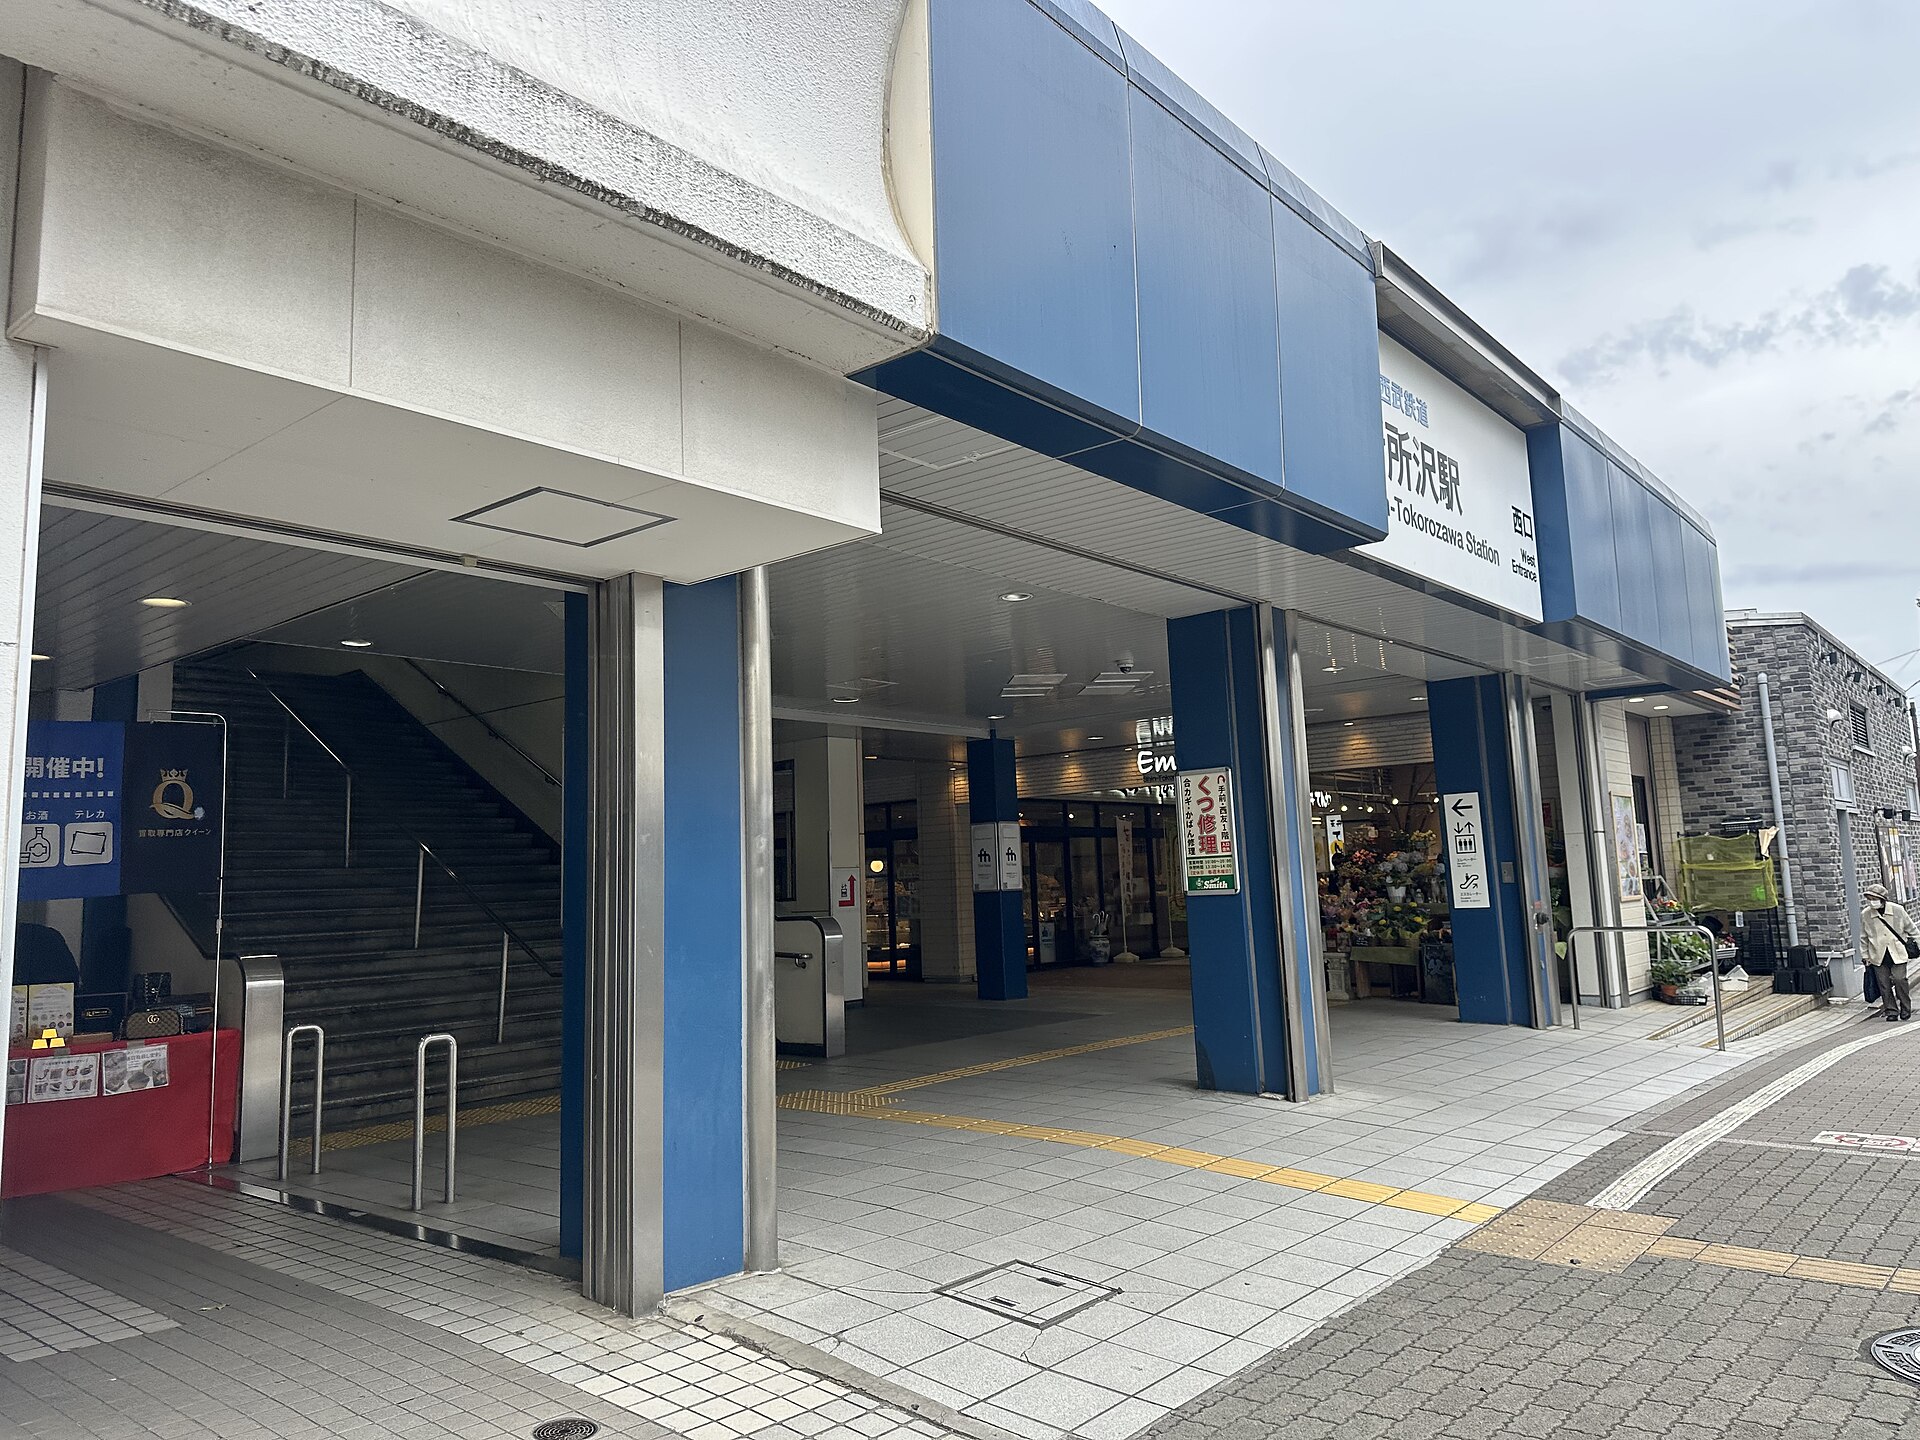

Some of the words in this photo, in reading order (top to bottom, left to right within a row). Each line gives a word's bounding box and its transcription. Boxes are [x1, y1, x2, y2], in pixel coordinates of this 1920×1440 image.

[1380, 376, 1429, 428] 西武鉄道
[1383, 422, 1463, 516] 所沢駅
[1388, 496, 1464, 549] -Tokorozawa
[1466, 530, 1500, 566] Station
[1511, 505, 1534, 541] 西口
[1520, 548, 1536, 568] West
[1511, 559, 1537, 583] Entrance
[25, 756, 104, 779] 開催中!
[1137, 750, 1177, 774] Em
[25, 810, 49, 821] お酒
[74, 809, 105, 820] テレカ
[1183, 778, 1196, 856] 合カギ・かばん修理
[1196, 775, 1218, 855] くつ修理
[1203, 880, 1228, 889] Smith
